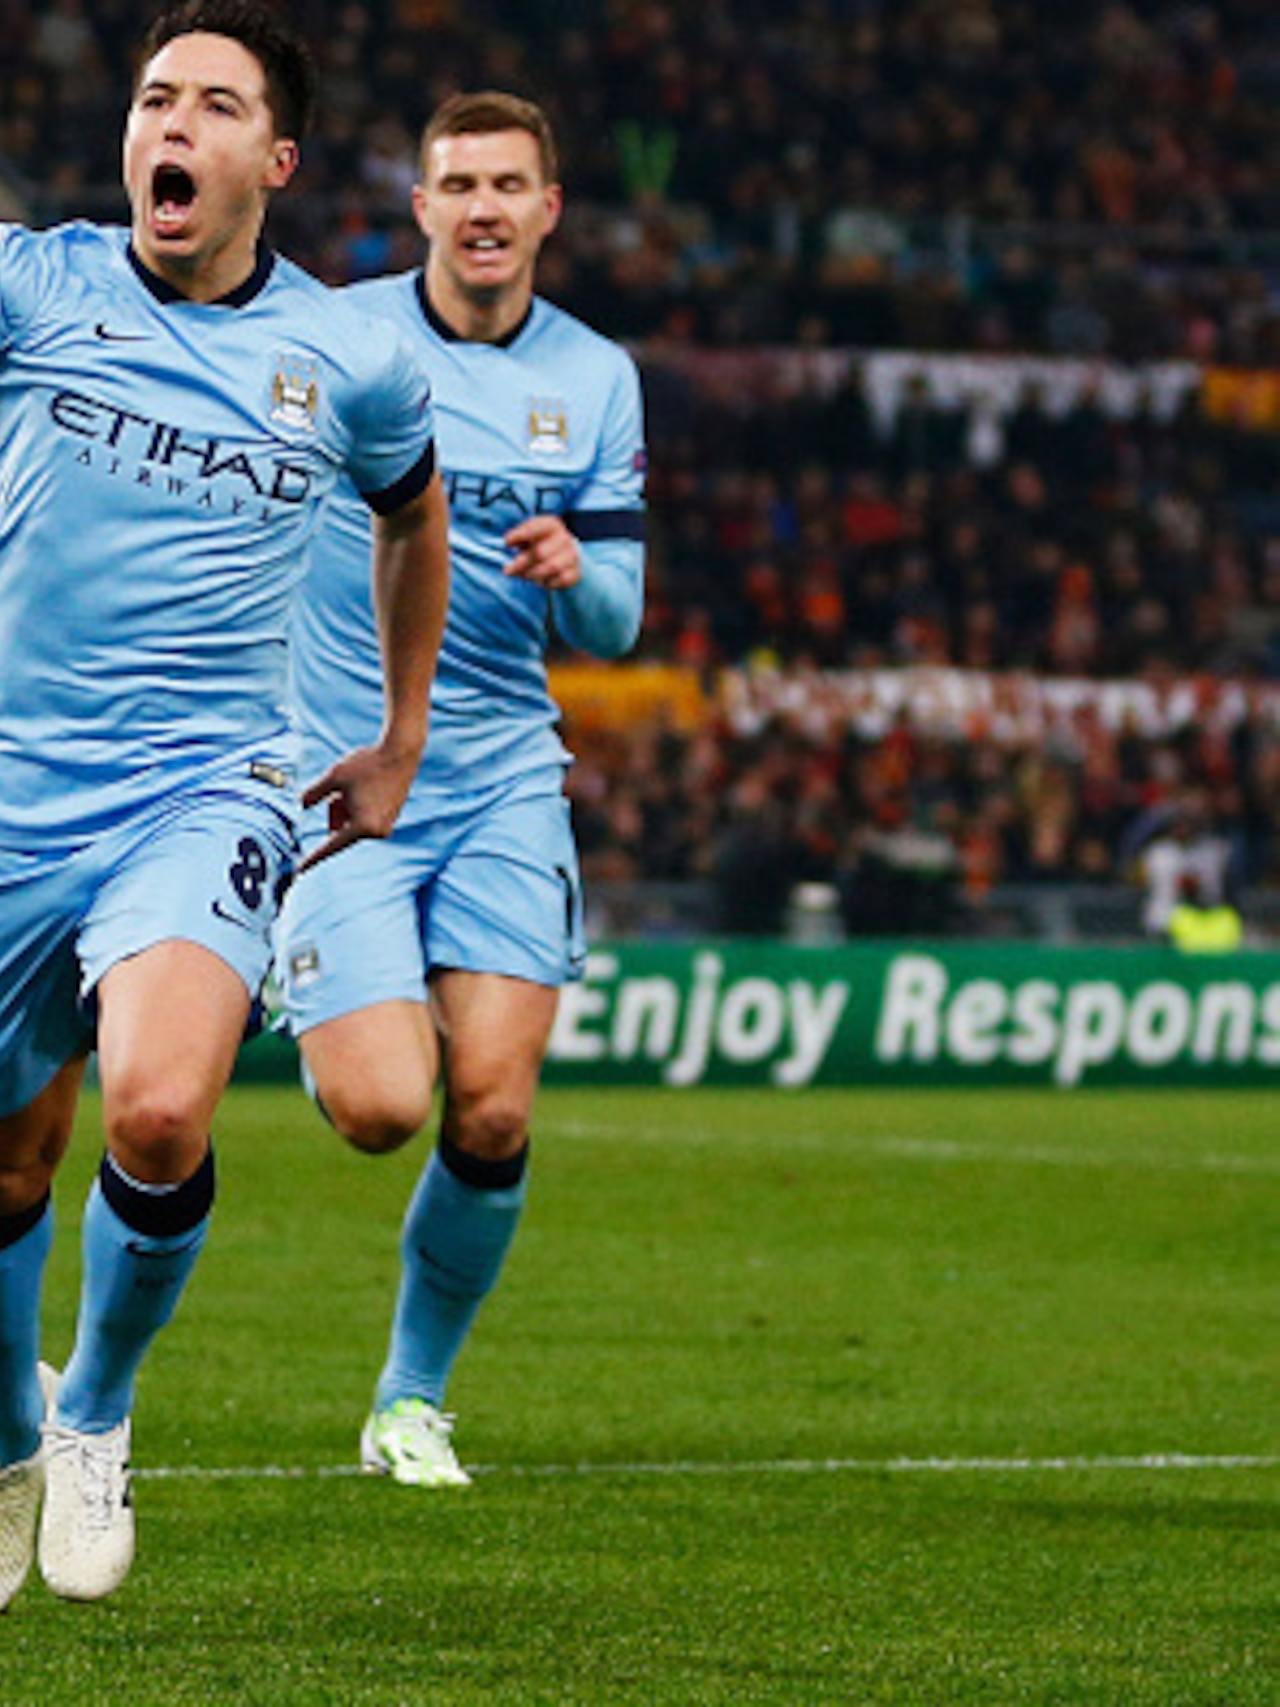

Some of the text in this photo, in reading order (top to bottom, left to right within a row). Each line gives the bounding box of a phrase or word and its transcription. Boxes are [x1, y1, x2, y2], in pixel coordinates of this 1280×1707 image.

[50, 390, 311, 503] ETIHAD
[229, 836, 266, 911] 8
[549, 954, 850, 1087] Enjoy
